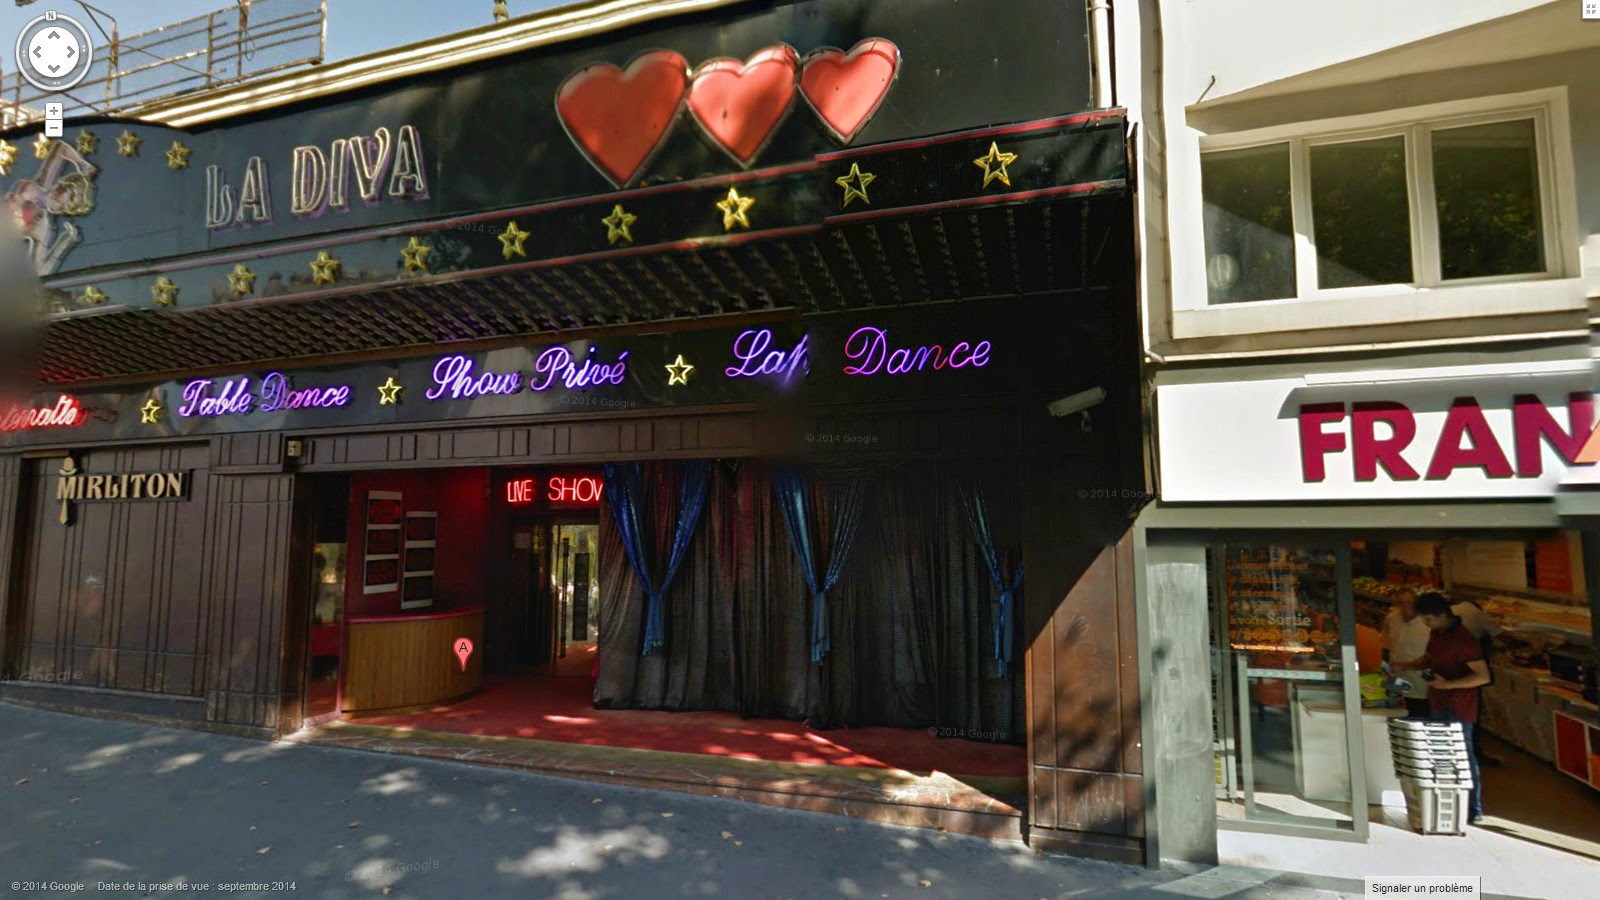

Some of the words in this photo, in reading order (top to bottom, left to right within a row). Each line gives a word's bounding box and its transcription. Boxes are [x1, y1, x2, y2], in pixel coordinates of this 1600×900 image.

[206, 156, 272, 230] LA
[291, 125, 428, 216] DIVA
[425, 355, 520, 400] Show
[530, 346, 628, 391] Privé
[843, 327, 991, 375] Dance
[178, 376, 252, 417] Table
[260, 371, 350, 412] Dance
[56, 472, 183, 500] MIRLITON
[507, 480, 533, 502] LIVE
[1267, 612, 1312, 626] Sortie
